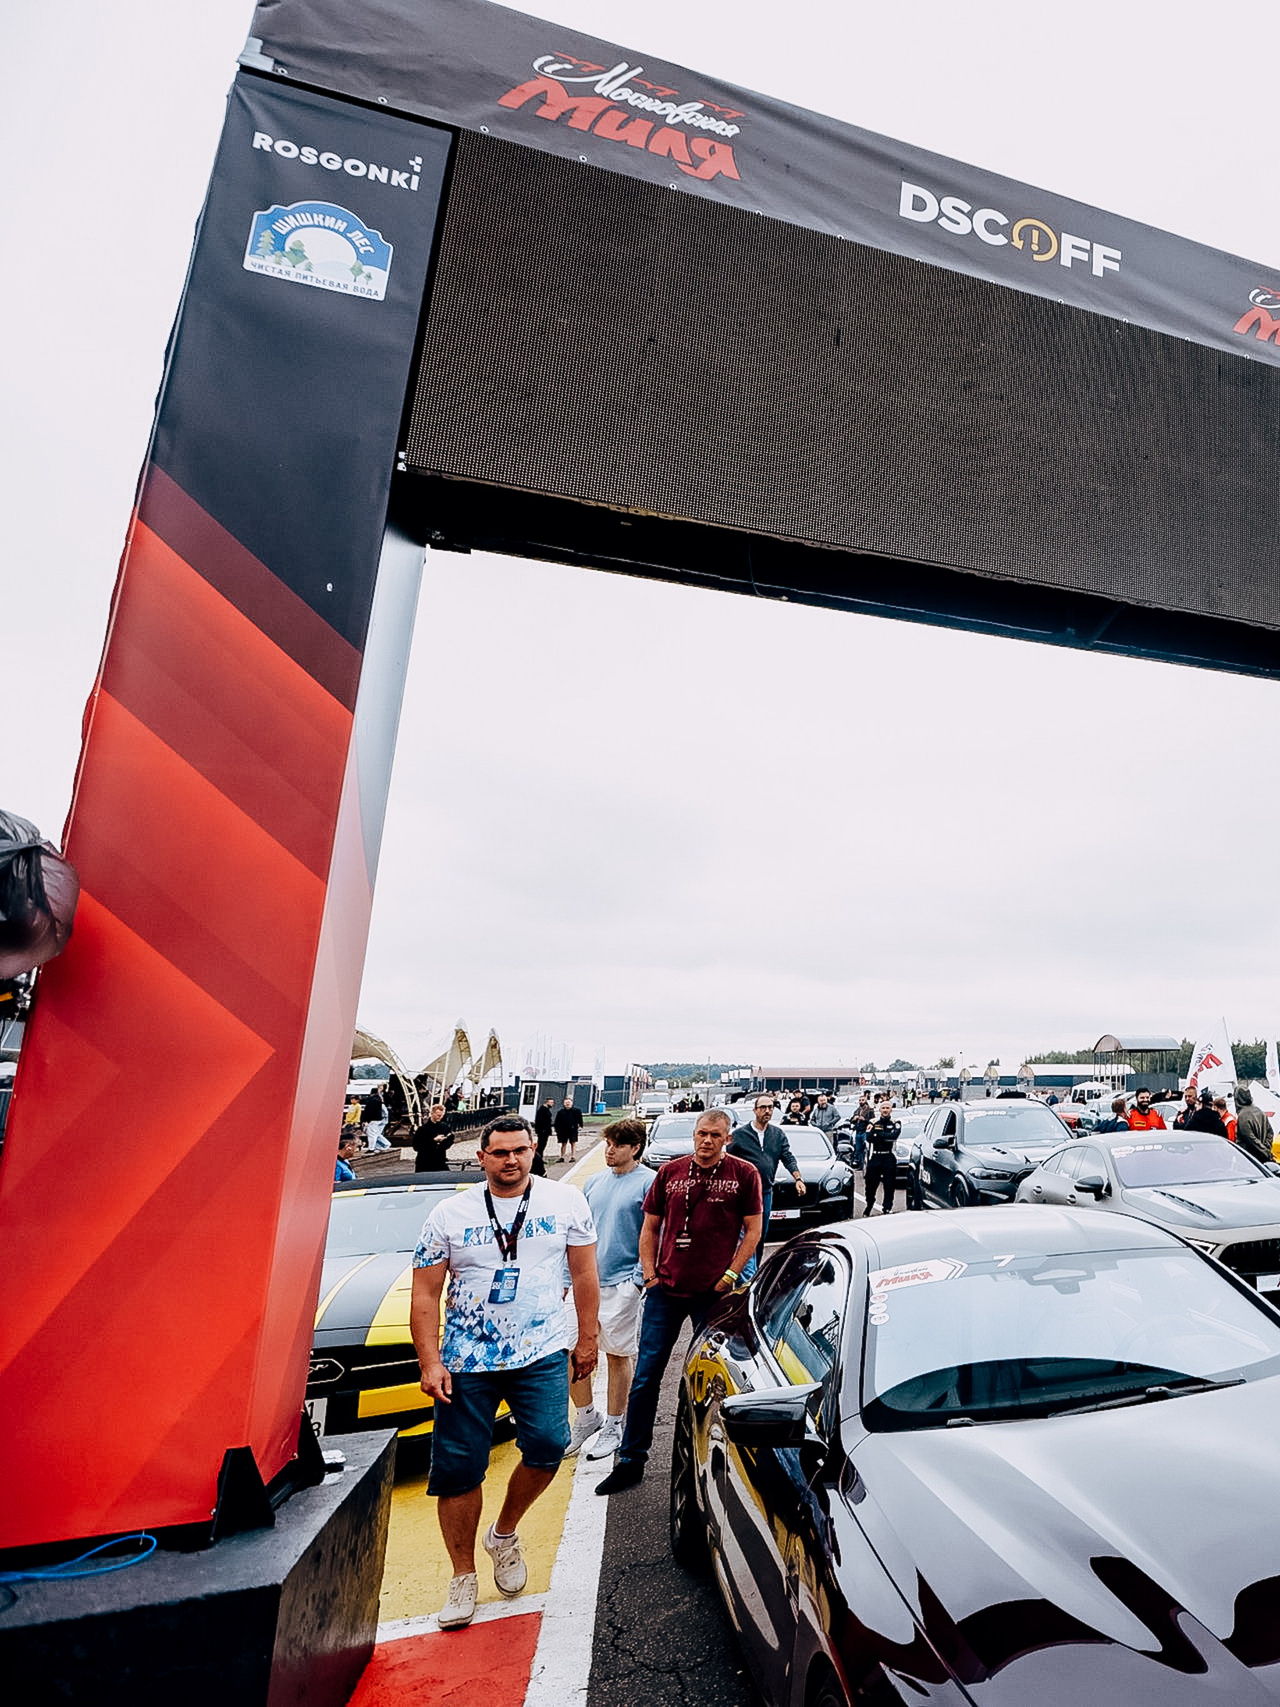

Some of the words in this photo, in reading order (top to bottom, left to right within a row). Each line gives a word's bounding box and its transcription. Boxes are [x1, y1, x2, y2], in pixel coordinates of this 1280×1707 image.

[252, 131, 422, 191] ROSGONKI
[271, 212, 348, 236] ШИШКИН
[346, 229, 375, 255] ЛЕС
[251, 261, 291, 277] ЧИСТАЯ
[295, 272, 349, 290] ПИТЬЕВАЯ
[353, 284, 379, 297] ВОДА
